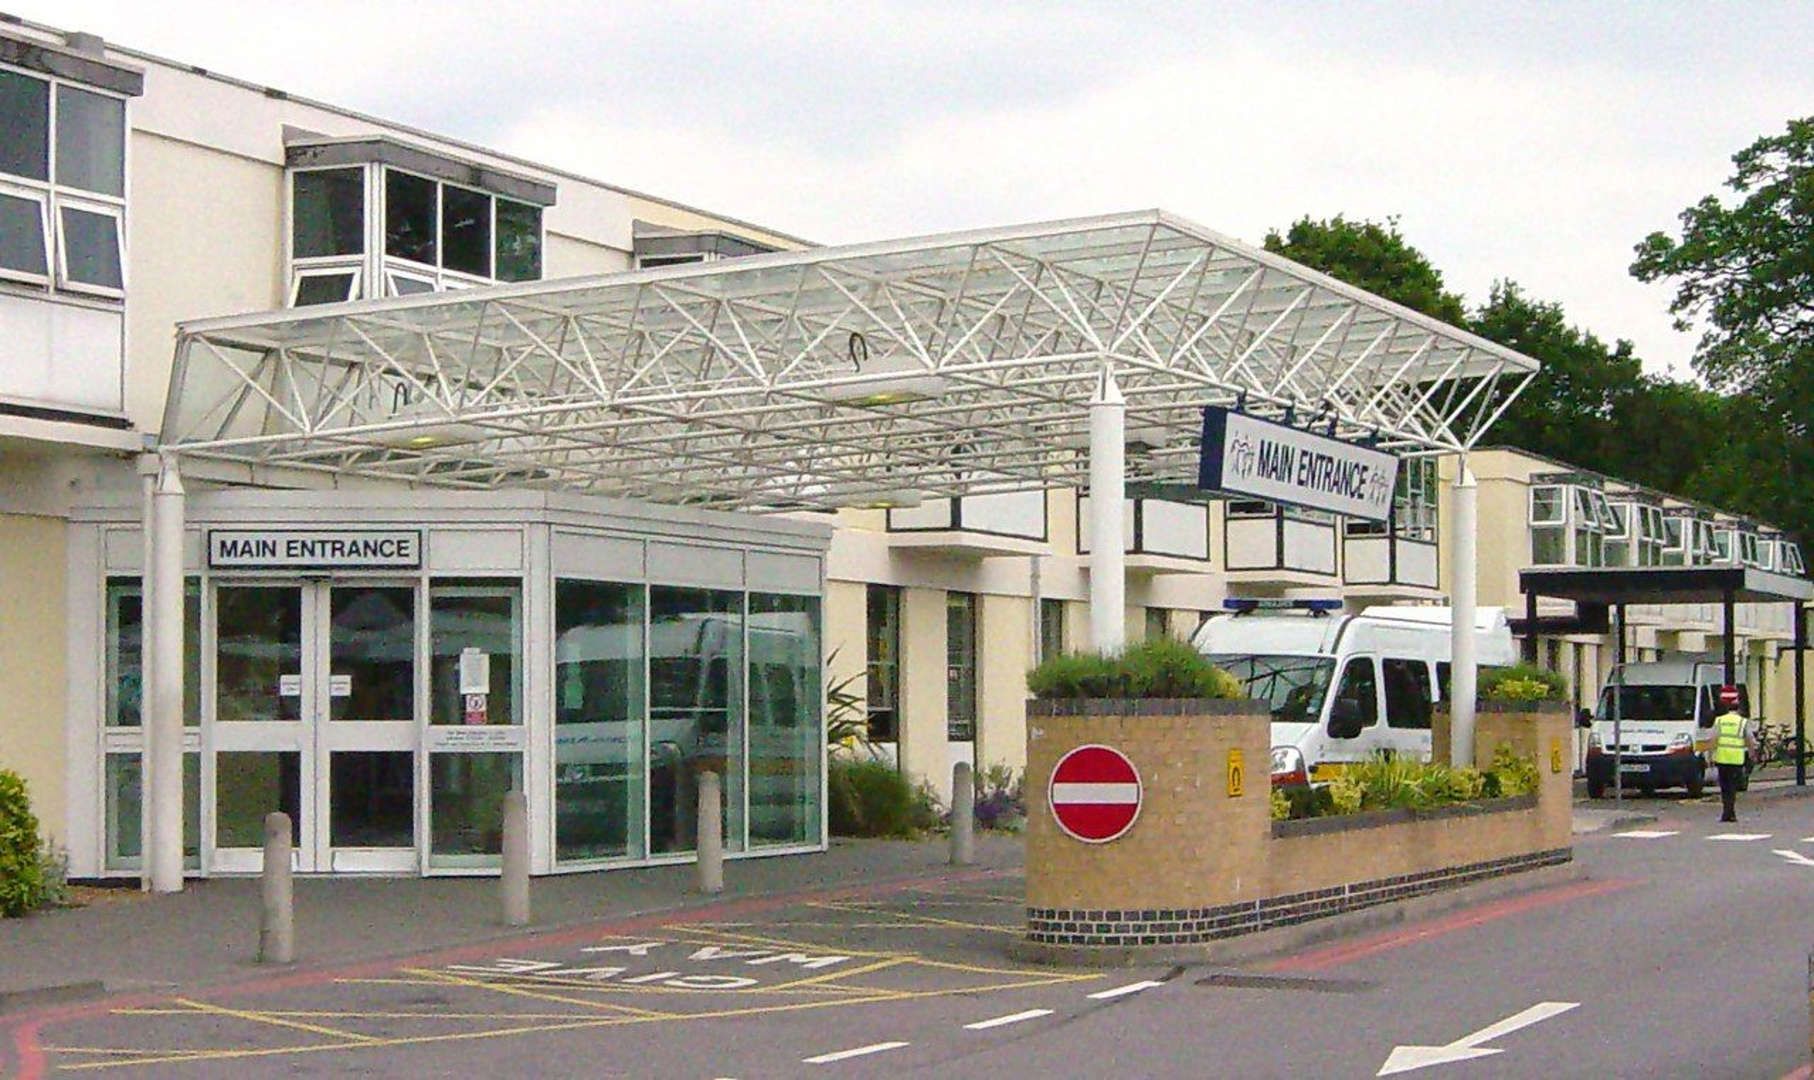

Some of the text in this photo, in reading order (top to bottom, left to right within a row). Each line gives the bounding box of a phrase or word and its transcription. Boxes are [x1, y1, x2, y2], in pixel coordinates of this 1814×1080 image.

[1257, 439, 1368, 500] MAIN ENTRANCE
[219, 539, 411, 558] MAIN ENTRANCE
[580, 941, 851, 969] WAY
[447, 958, 759, 989] GIVE
